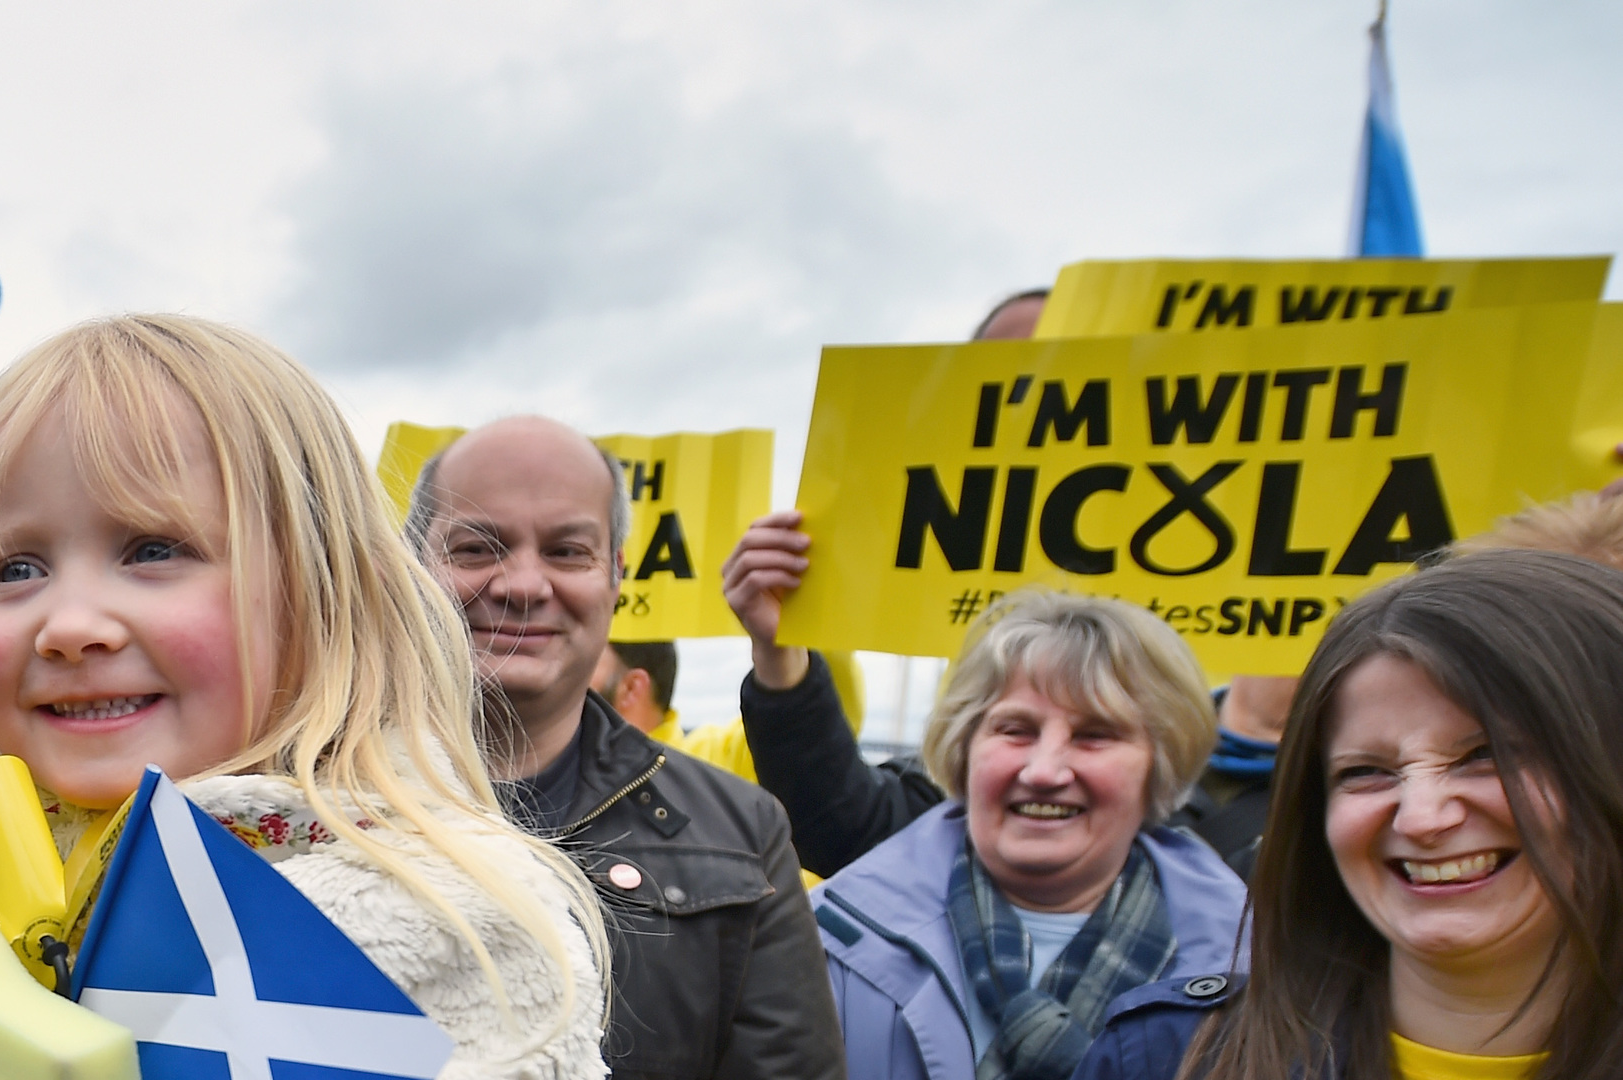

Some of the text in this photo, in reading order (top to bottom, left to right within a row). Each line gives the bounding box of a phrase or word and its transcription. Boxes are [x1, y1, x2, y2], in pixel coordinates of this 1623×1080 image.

[1156, 281, 1258, 329] I'M
[973, 362, 1409, 448] I'M WITH
